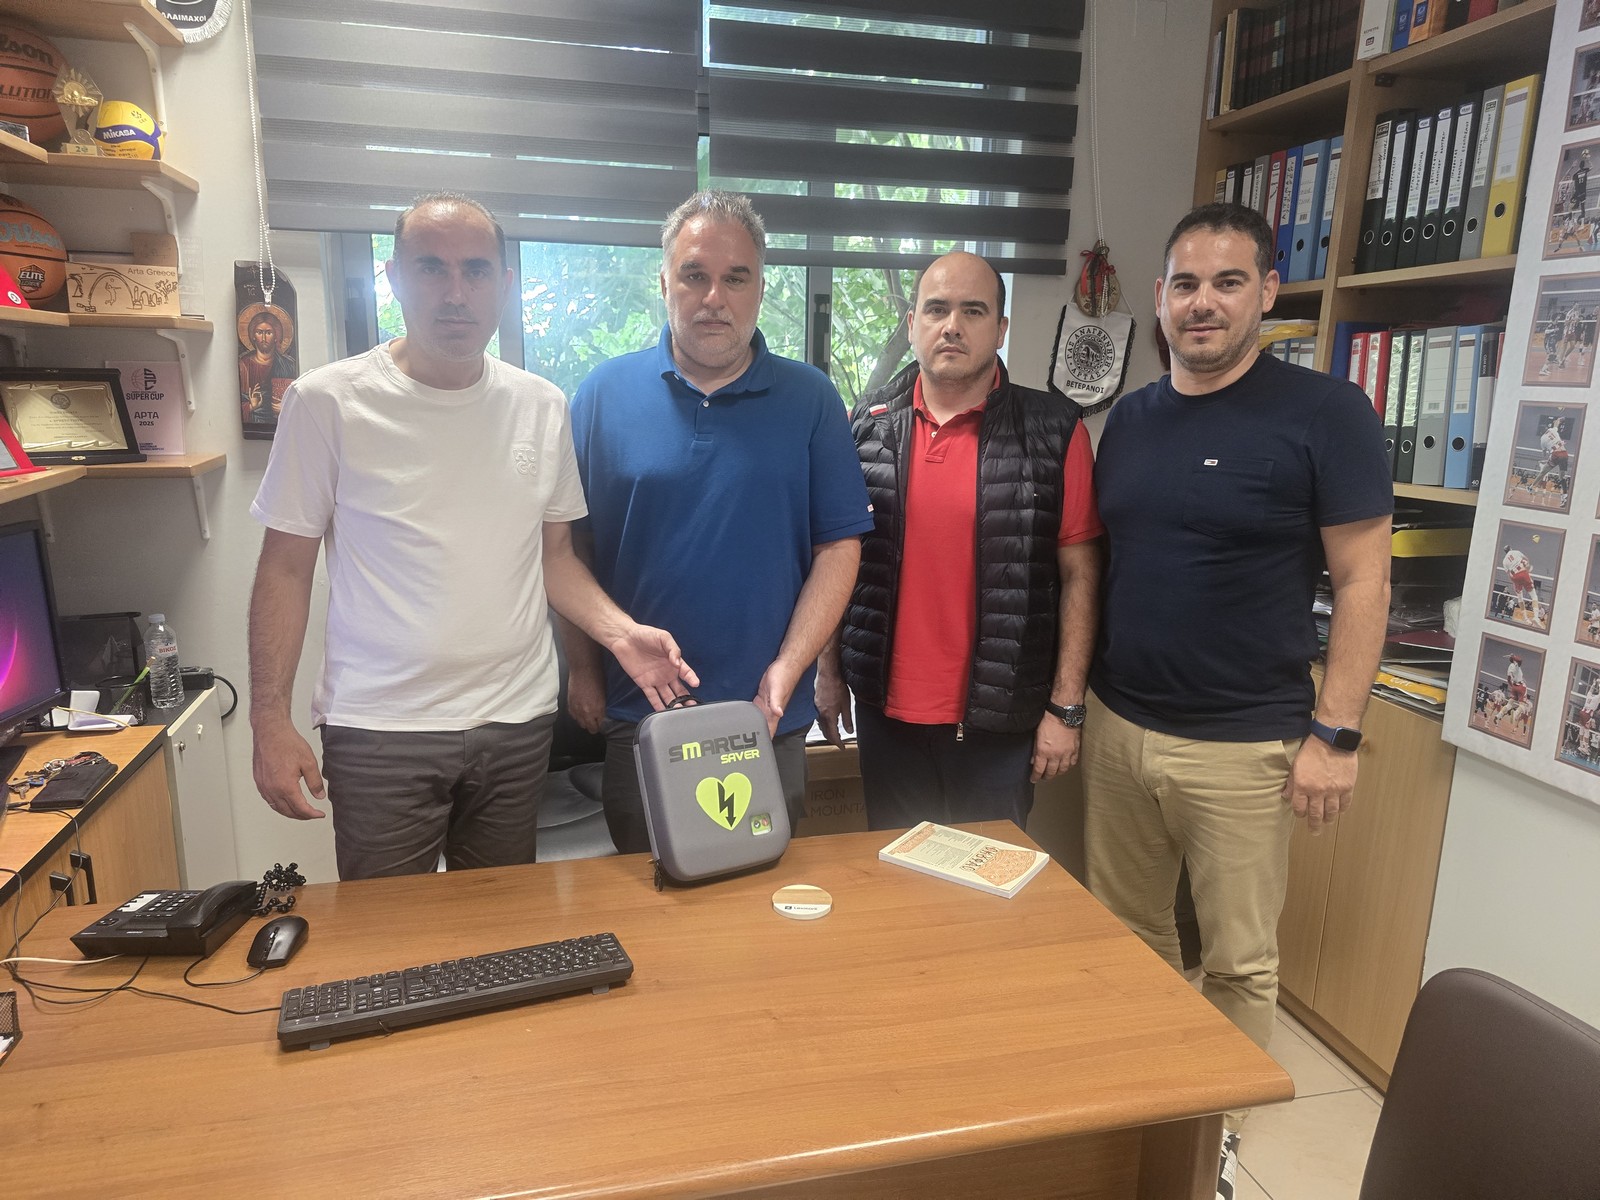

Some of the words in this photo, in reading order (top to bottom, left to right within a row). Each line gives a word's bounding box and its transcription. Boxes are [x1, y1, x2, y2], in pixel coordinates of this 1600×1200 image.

[161, 11, 207, 22] ΑΛΑΙΜΑΧΟΙ
[20, 271, 44, 281] ELITE
[127, 267, 145, 275] Arta
[146, 268, 176, 277] Greece
[1065, 380, 1105, 394] ΒΕΤΕΡΑΝΟΙ
[126, 392, 150, 401] SUPER
[150, 392, 165, 401] CUP
[720, 749, 760, 764] SAVER
[811, 789, 845, 801] IRON
